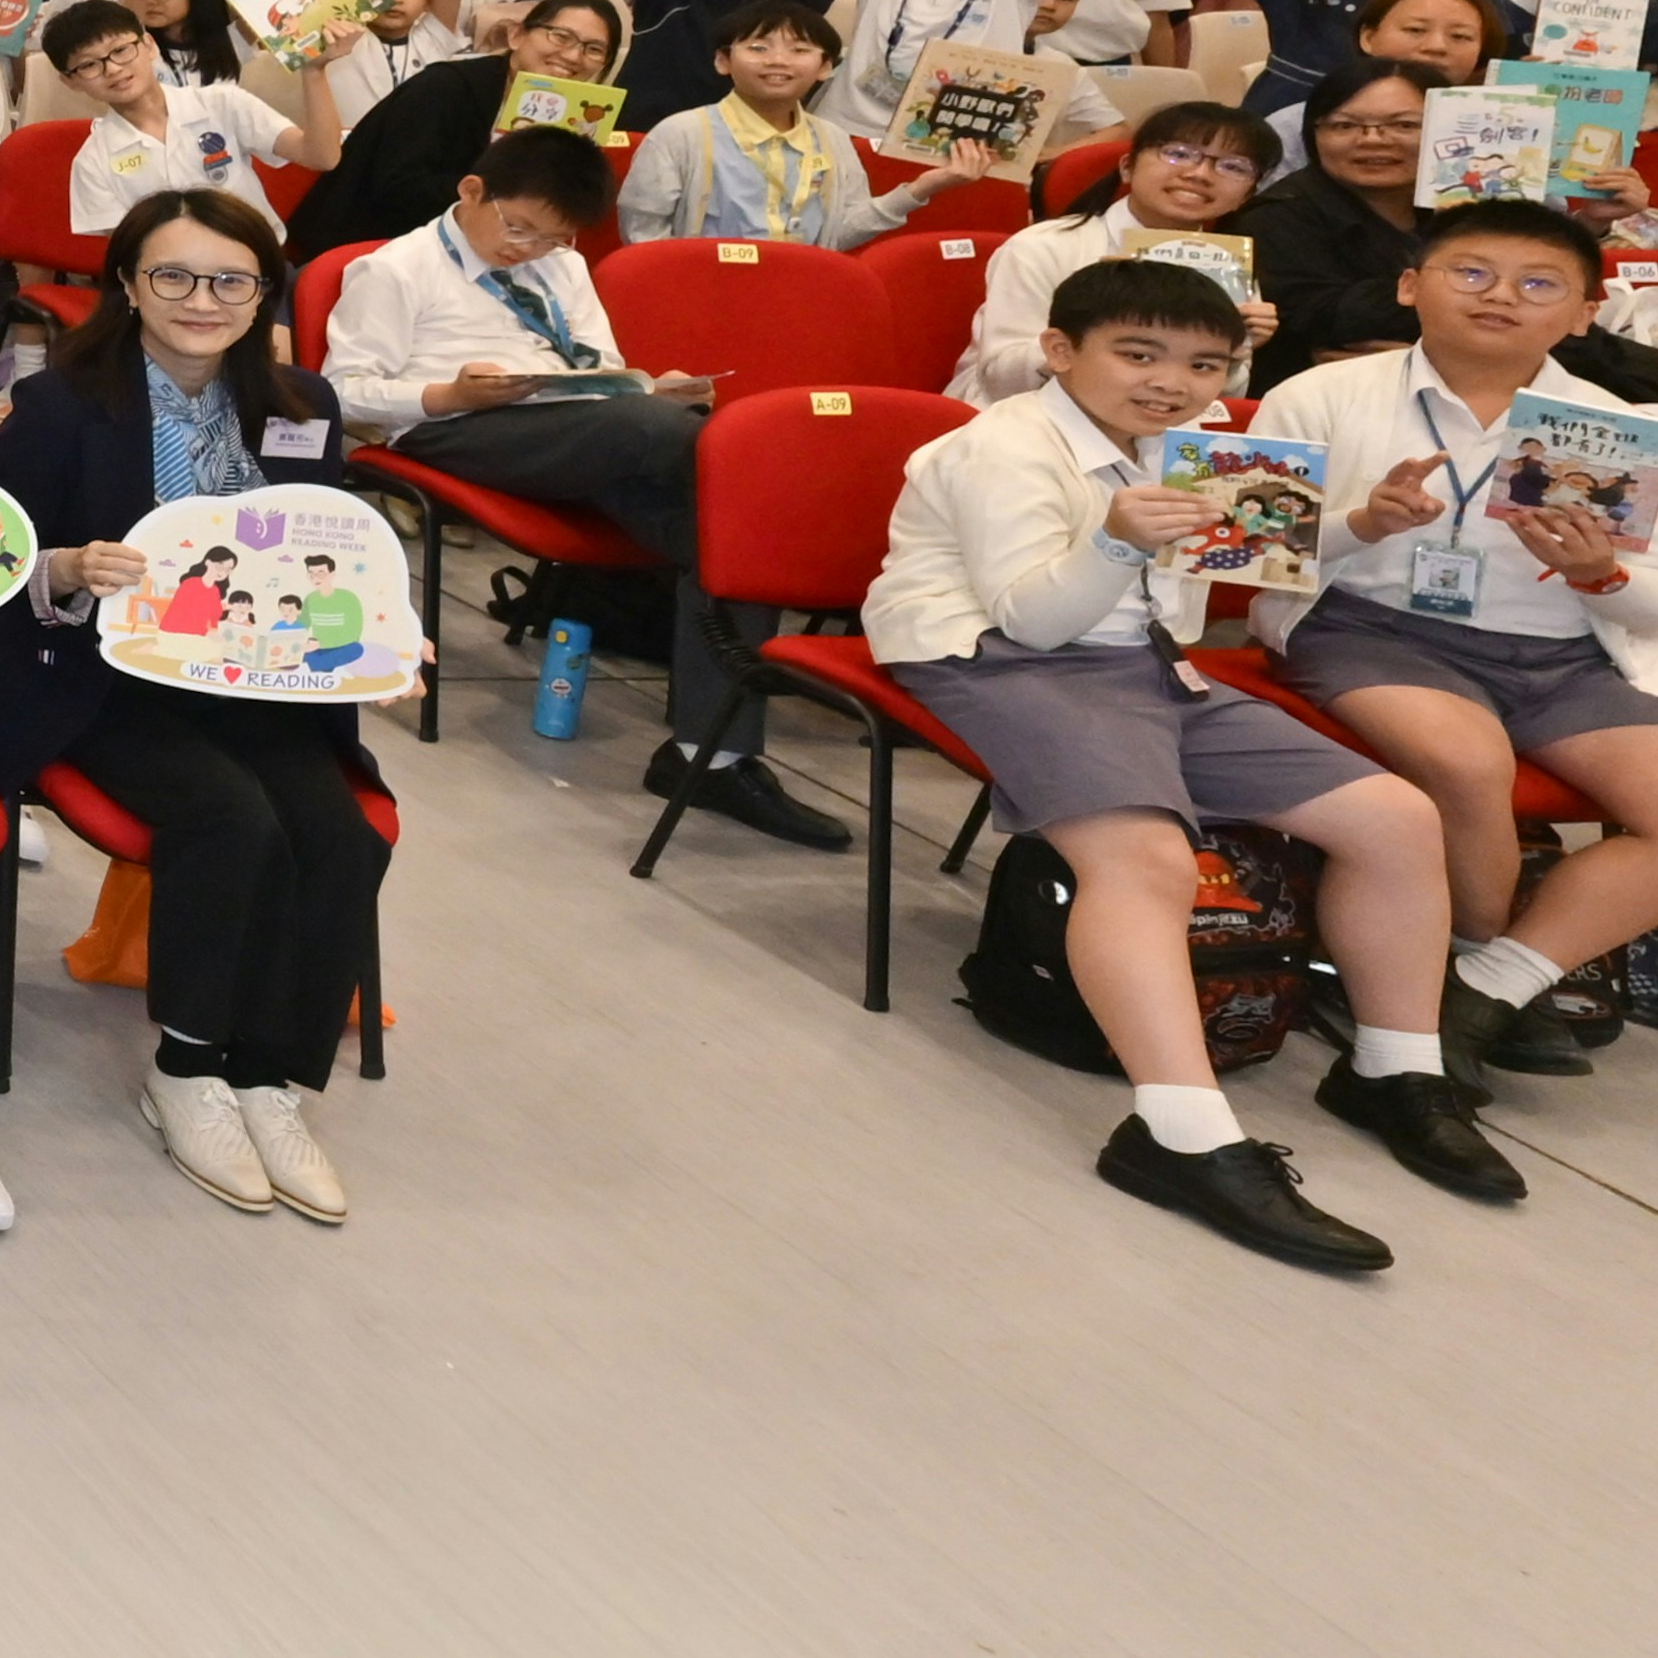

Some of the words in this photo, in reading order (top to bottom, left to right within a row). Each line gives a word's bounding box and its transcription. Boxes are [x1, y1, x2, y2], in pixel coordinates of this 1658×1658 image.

[1552, 1, 1634, 21] CONFIDENT
[722, 246, 756, 261] B-09
[944, 242, 973, 256] B-08
[1622, 266, 1657, 279] B-06
[816, 396, 847, 412] A-09
[293, 512, 372, 533] 香港悅讀周
[291, 528, 321, 540] HONG
[322, 531, 355, 542] KONG
[290, 537, 338, 550] READING
[338, 541, 368, 553] WEEK
[189, 663, 218, 681] WE
[245, 669, 336, 691] READING
